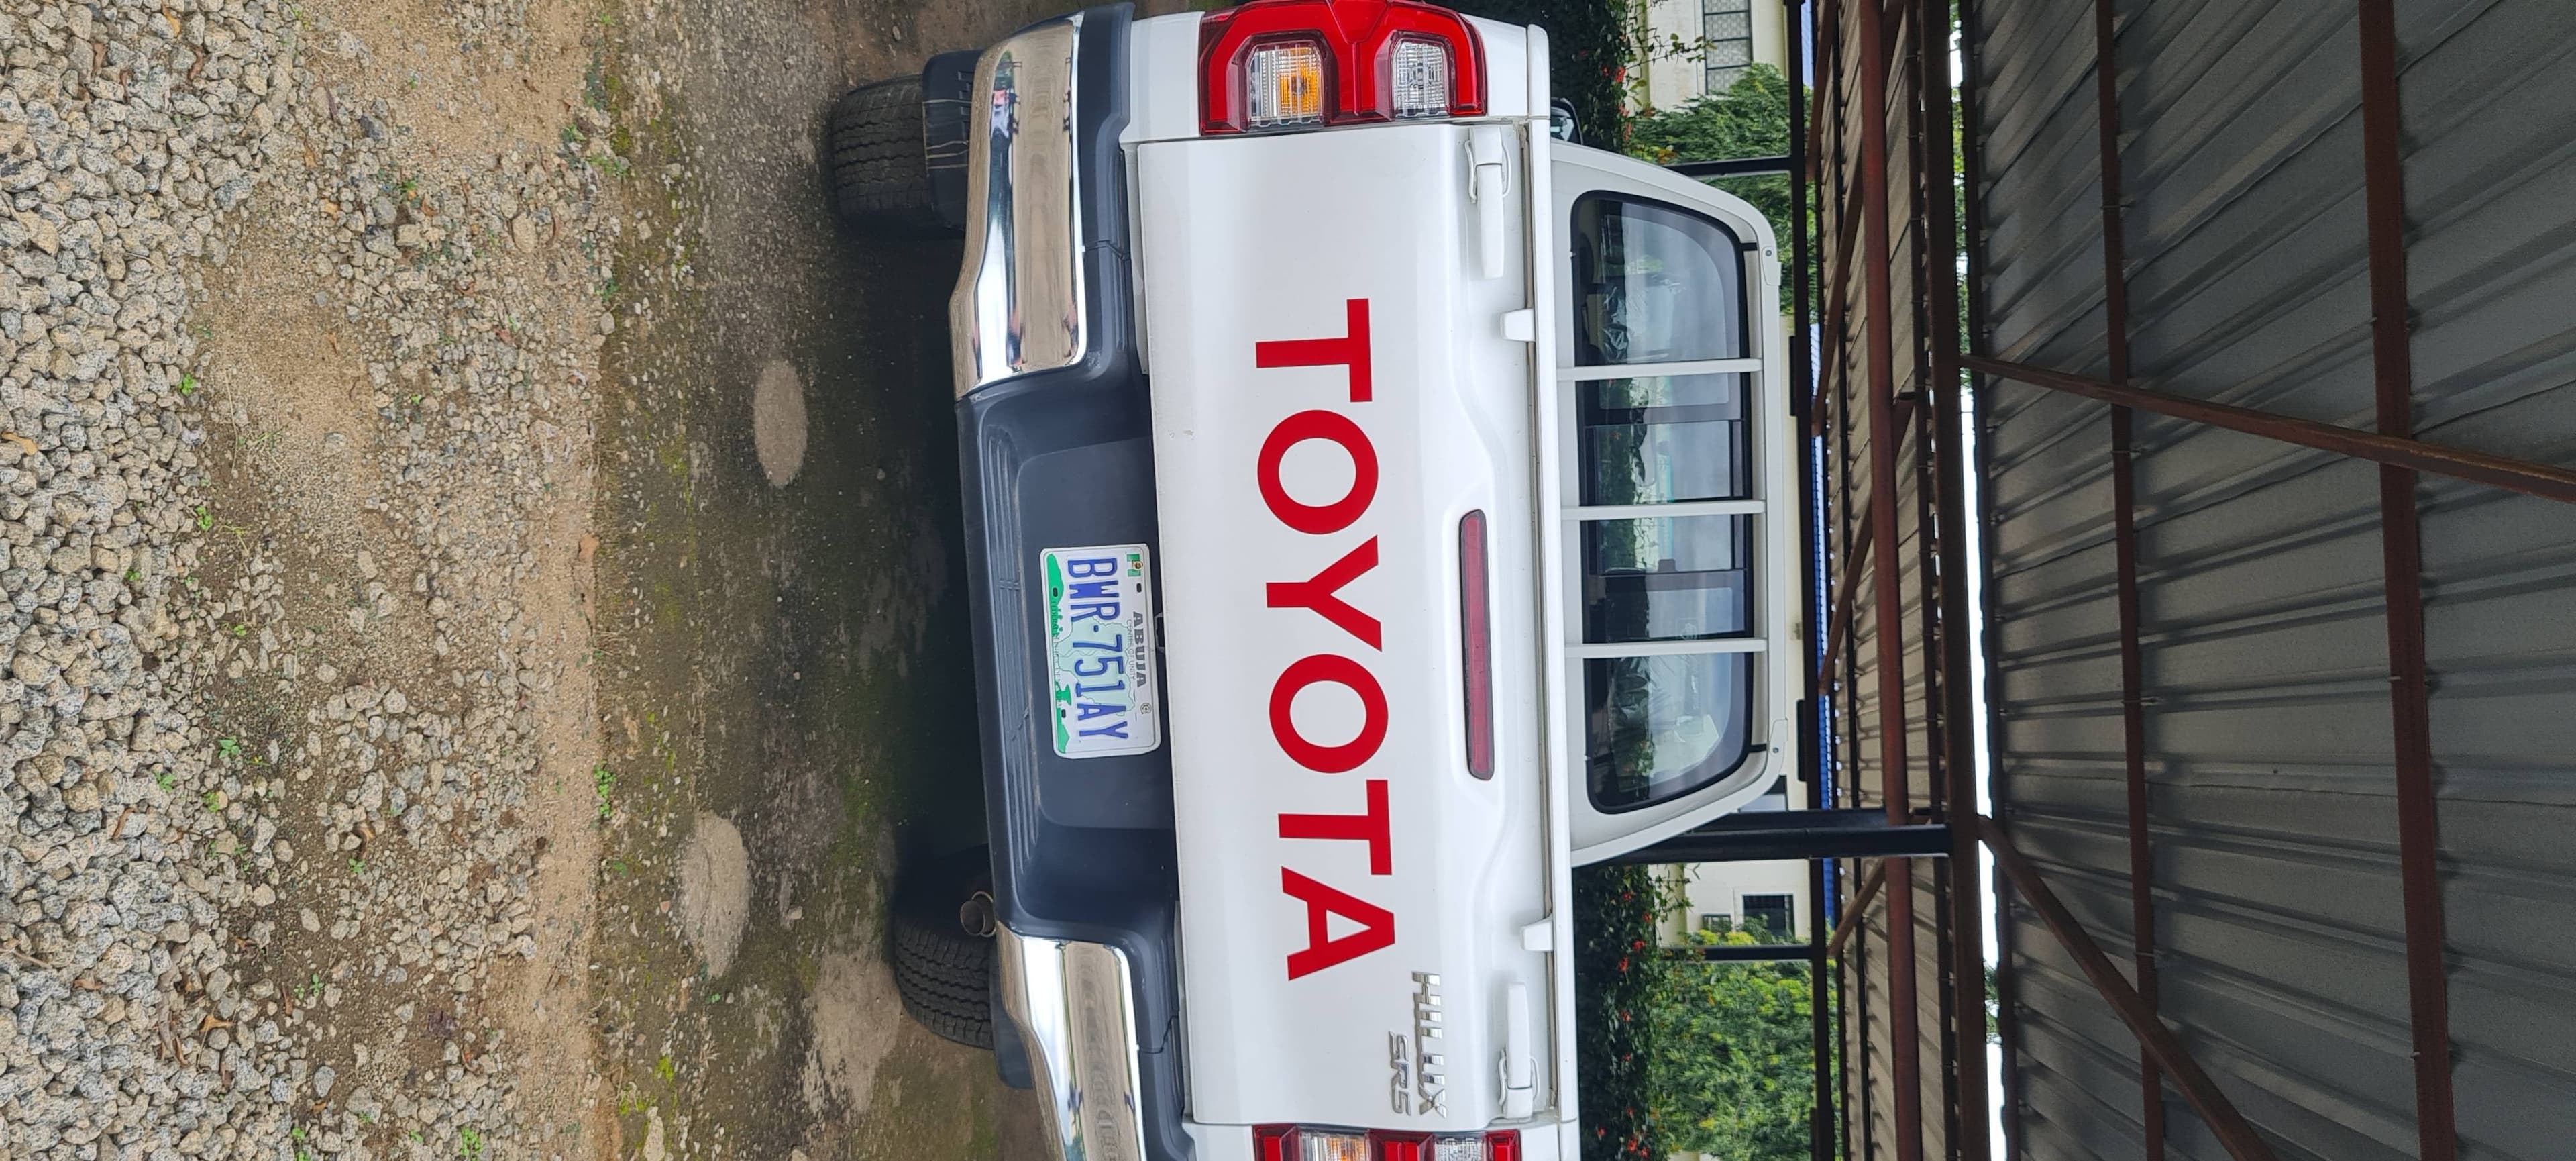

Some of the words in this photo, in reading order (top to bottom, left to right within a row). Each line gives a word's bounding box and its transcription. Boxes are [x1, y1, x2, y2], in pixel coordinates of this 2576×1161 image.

[1067, 558, 1128, 739] BWR-751AY
[1128, 649, 1134, 658] OF
[1133, 611, 1146, 687] ABUJA
[1256, 299, 1395, 980] TOYOTA
[1389, 1031, 1411, 1116] SR5
[1412, 971, 1448, 1119] HILUX
